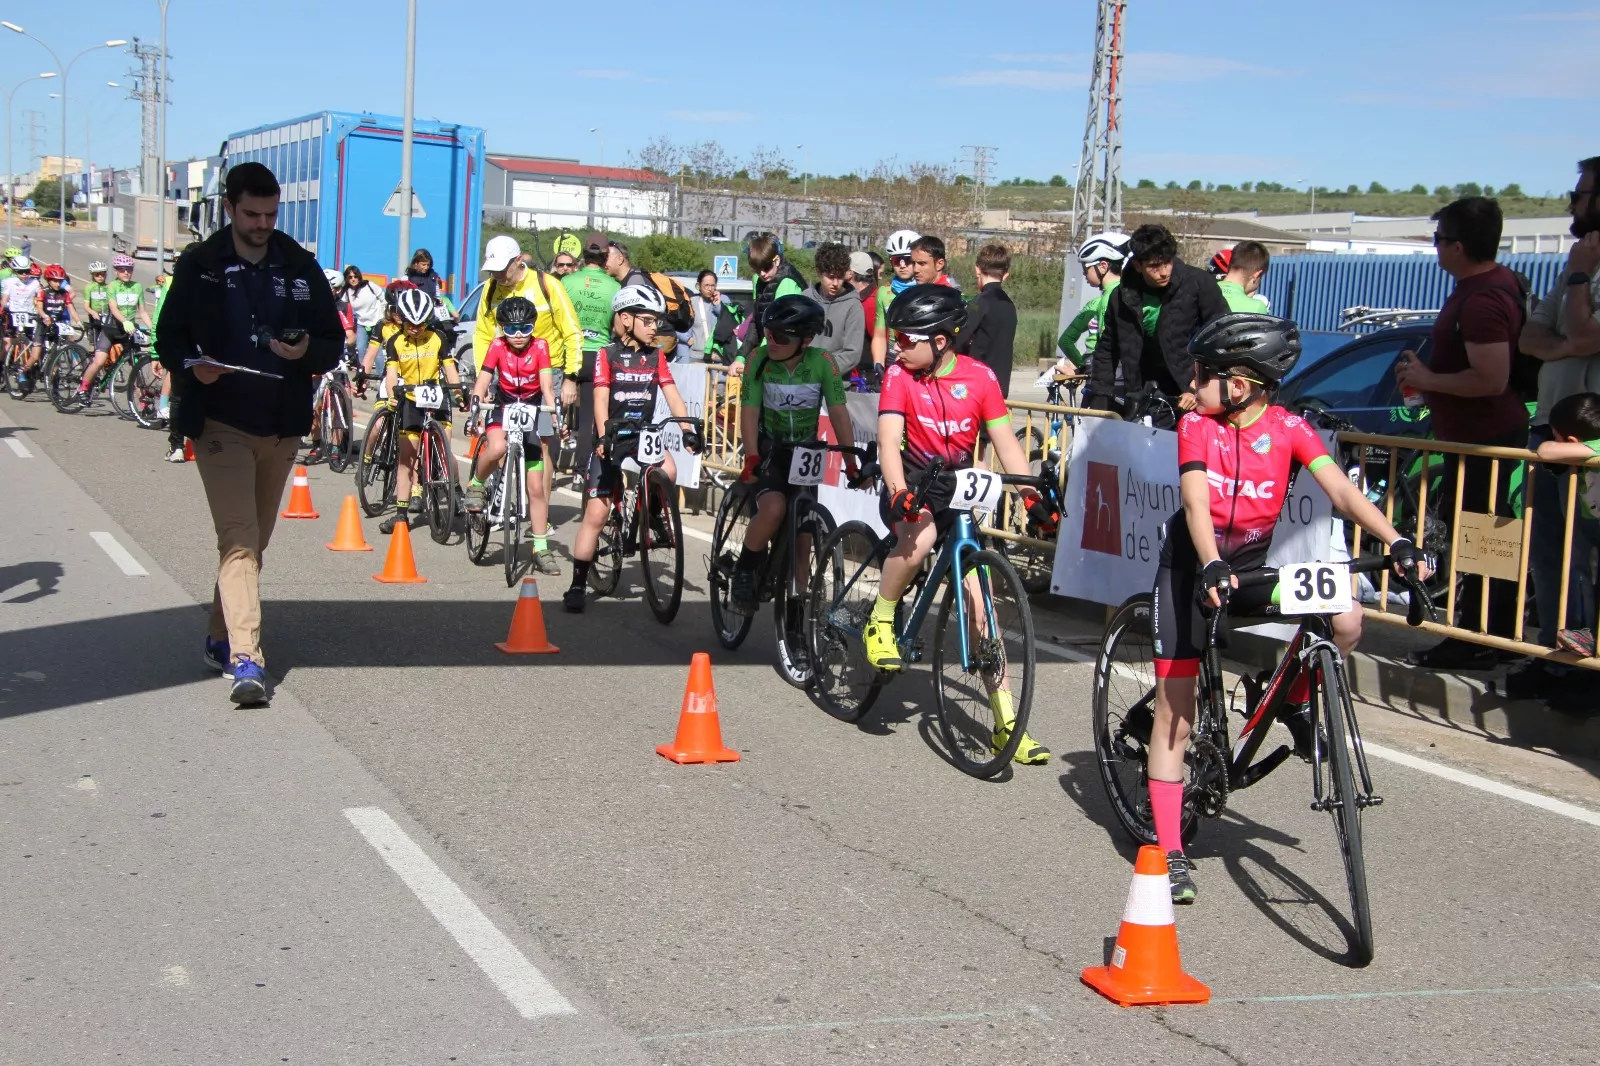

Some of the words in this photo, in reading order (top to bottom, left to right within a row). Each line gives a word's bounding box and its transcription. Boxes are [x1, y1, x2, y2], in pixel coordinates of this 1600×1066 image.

[615, 372, 655, 382] SETEK
[421, 387, 438, 402] 43
[509, 412, 529, 426] 40
[938, 417, 972, 436] TAC
[644, 434, 662, 456] 39
[798, 451, 823, 477] 38
[963, 471, 993, 502] 37
[1224, 477, 1276, 499] TAC
[1125, 522, 1150, 562] de
[1293, 567, 1337, 602] 36
